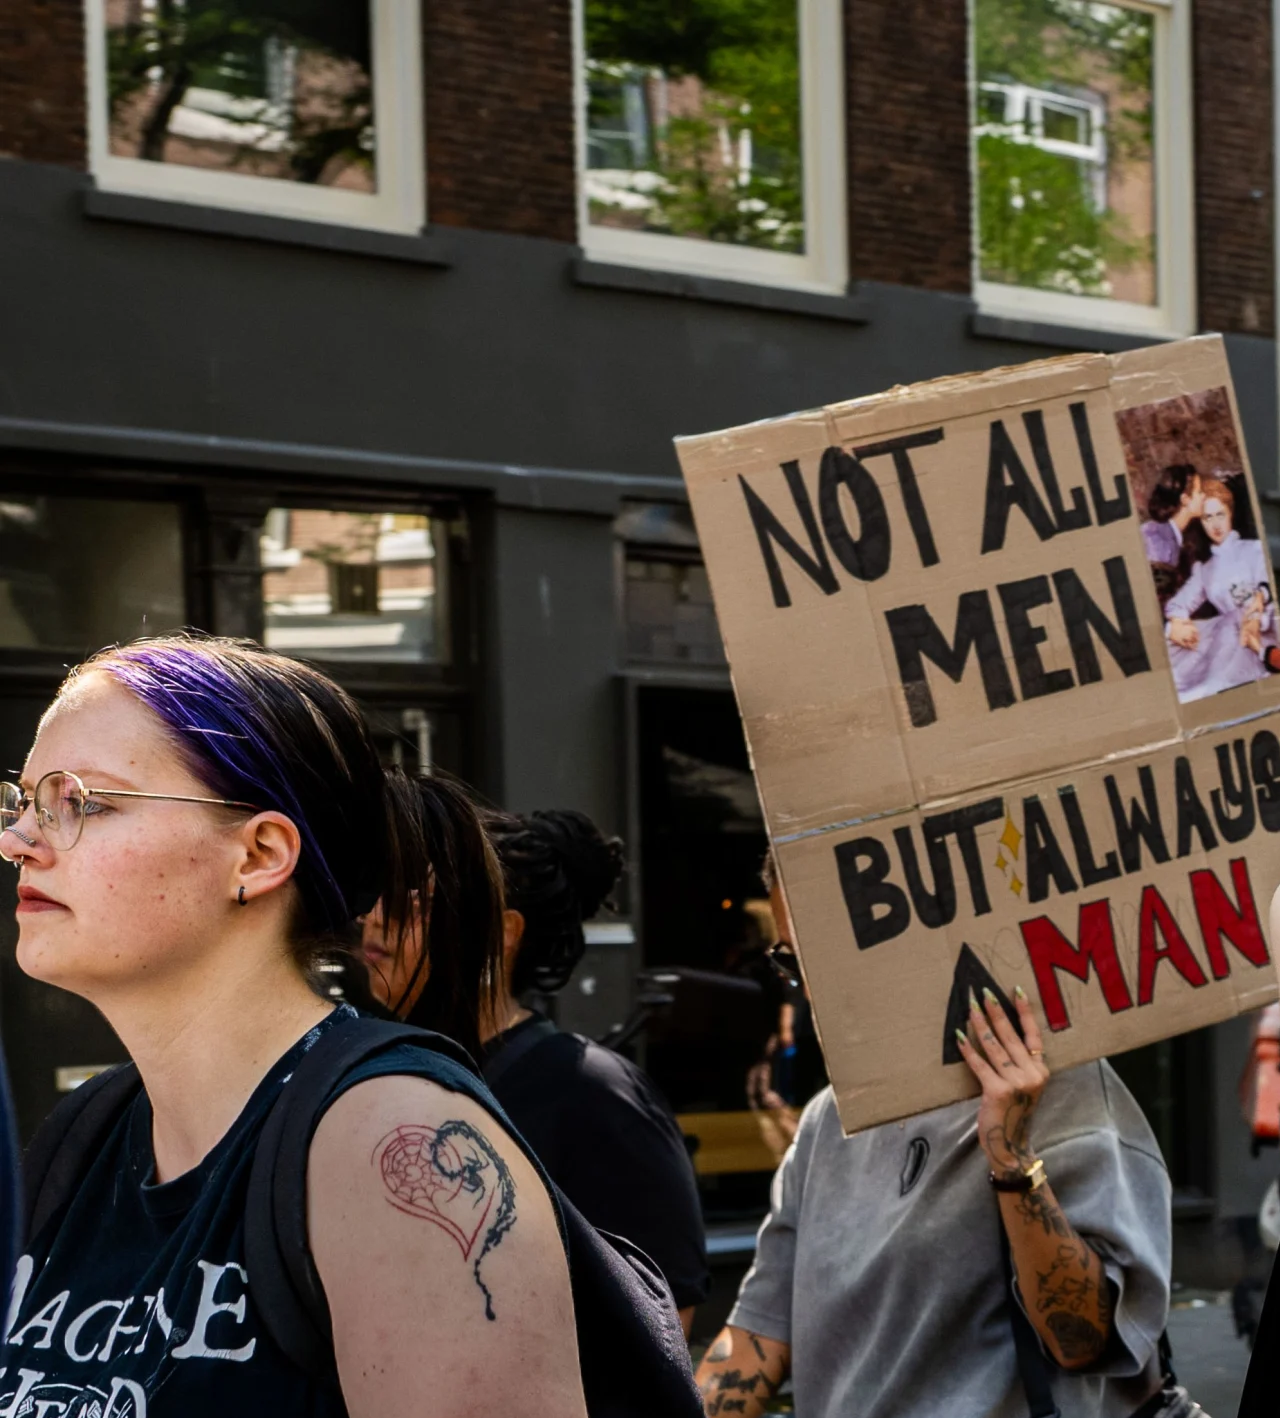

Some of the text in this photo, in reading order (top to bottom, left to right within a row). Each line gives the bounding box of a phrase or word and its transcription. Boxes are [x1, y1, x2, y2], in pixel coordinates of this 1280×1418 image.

[738, 402, 1132, 608] NOT ALL
[884, 556, 1151, 727] MEN
[833, 797, 1004, 950] BUT
[942, 857, 1271, 1065] A MAN
